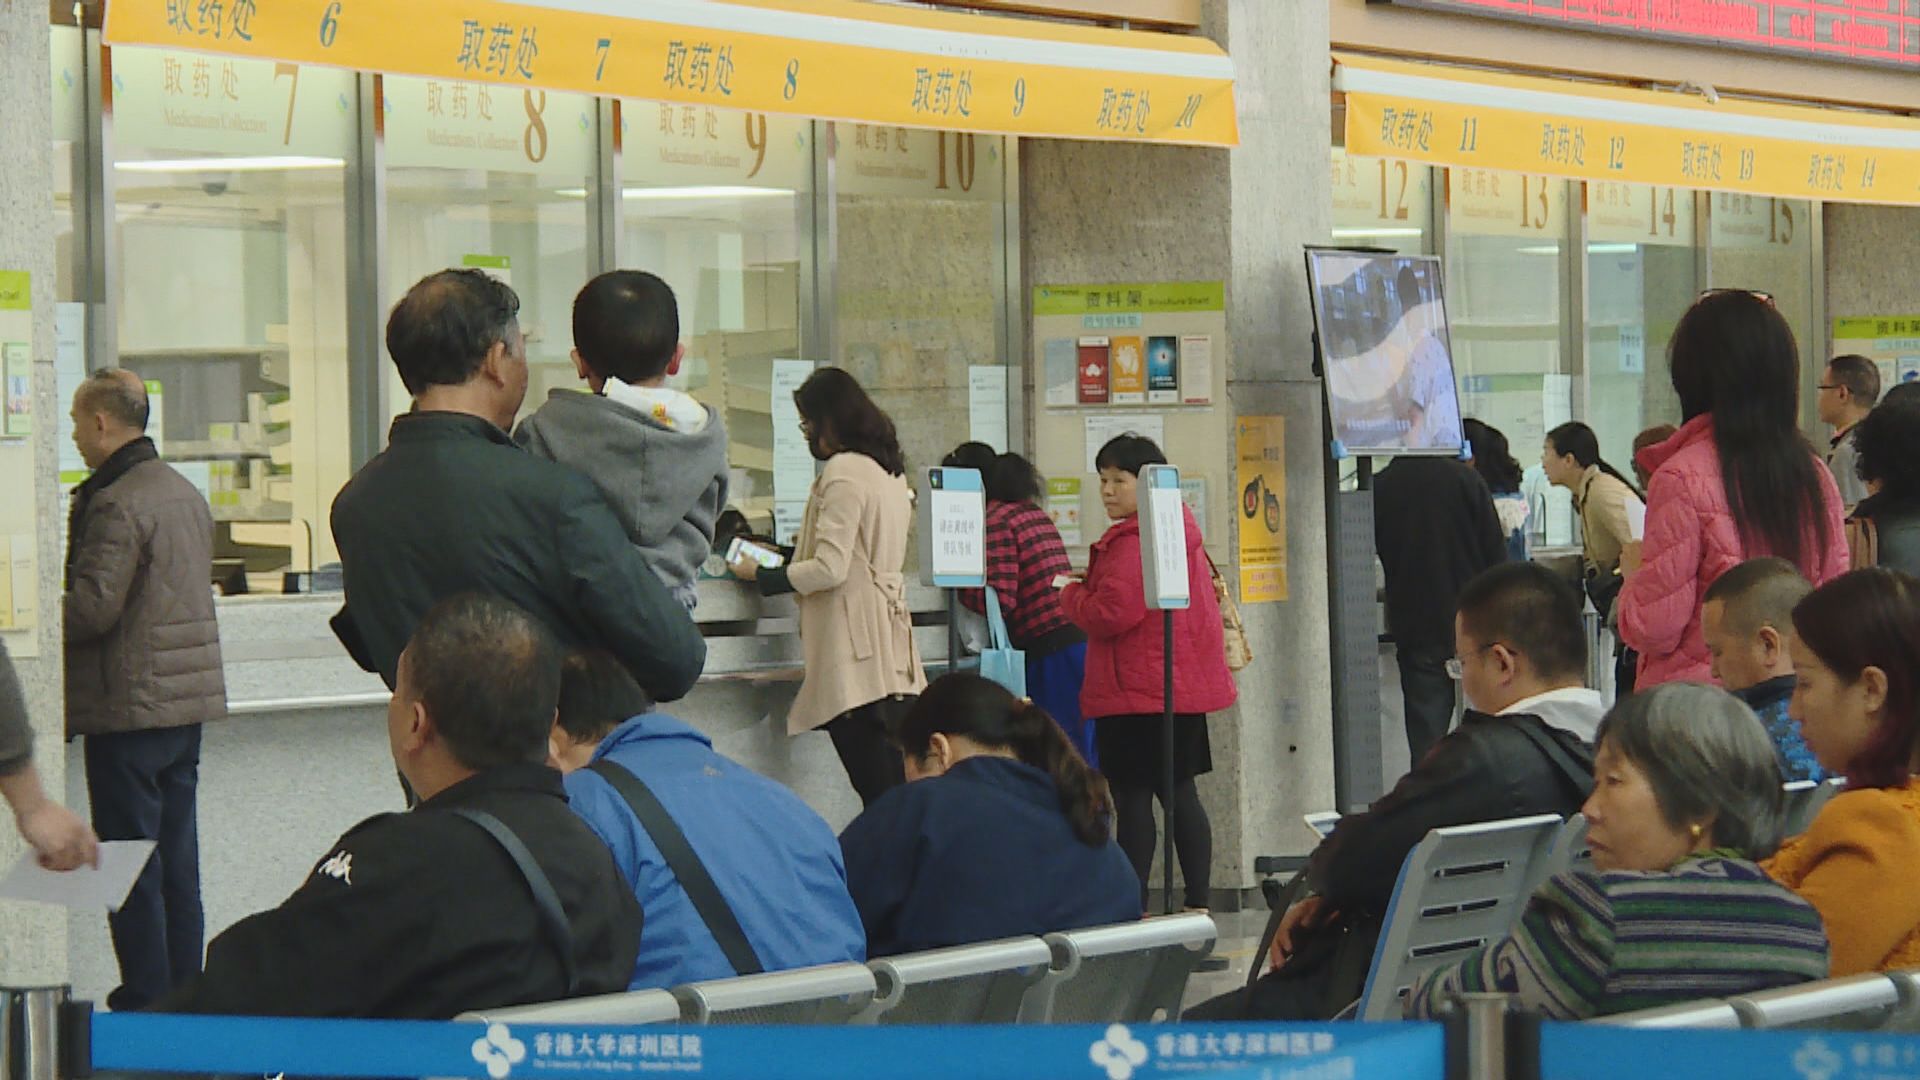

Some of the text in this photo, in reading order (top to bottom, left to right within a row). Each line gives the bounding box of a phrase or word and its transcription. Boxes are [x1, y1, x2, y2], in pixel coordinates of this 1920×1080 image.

[166, 0, 342, 48] 取药处 6
[457, 20, 611, 81] 取药处 7
[663, 40, 799, 101] 取药处 8
[163, 57, 239, 102] 取药处
[426, 81, 492, 121] 取药处
[911, 68, 1026, 117] 取药处 9
[274, 62, 299, 146] 7
[523, 88, 548, 163] 8
[658, 103, 718, 140] 取药处
[1096, 87, 1202, 133] 取药处 10
[745, 112, 767, 179] 9
[1381, 107, 1477, 152] 取药处 11
[1540, 122, 1625, 169] 取药处 12
[935, 130, 975, 192] 10
[1681, 141, 1755, 182] 取药处 13
[1807, 153, 1877, 191] 取药处 14
[1377, 158, 1409, 220] 12
[1517, 174, 1550, 230] 13
[1648, 186, 1676, 237] 14
[1768, 197, 1794, 245] 15
[1086, 290, 1143, 308] 资料架
[533, 1032, 702, 1057] 香港大学深圳医院
